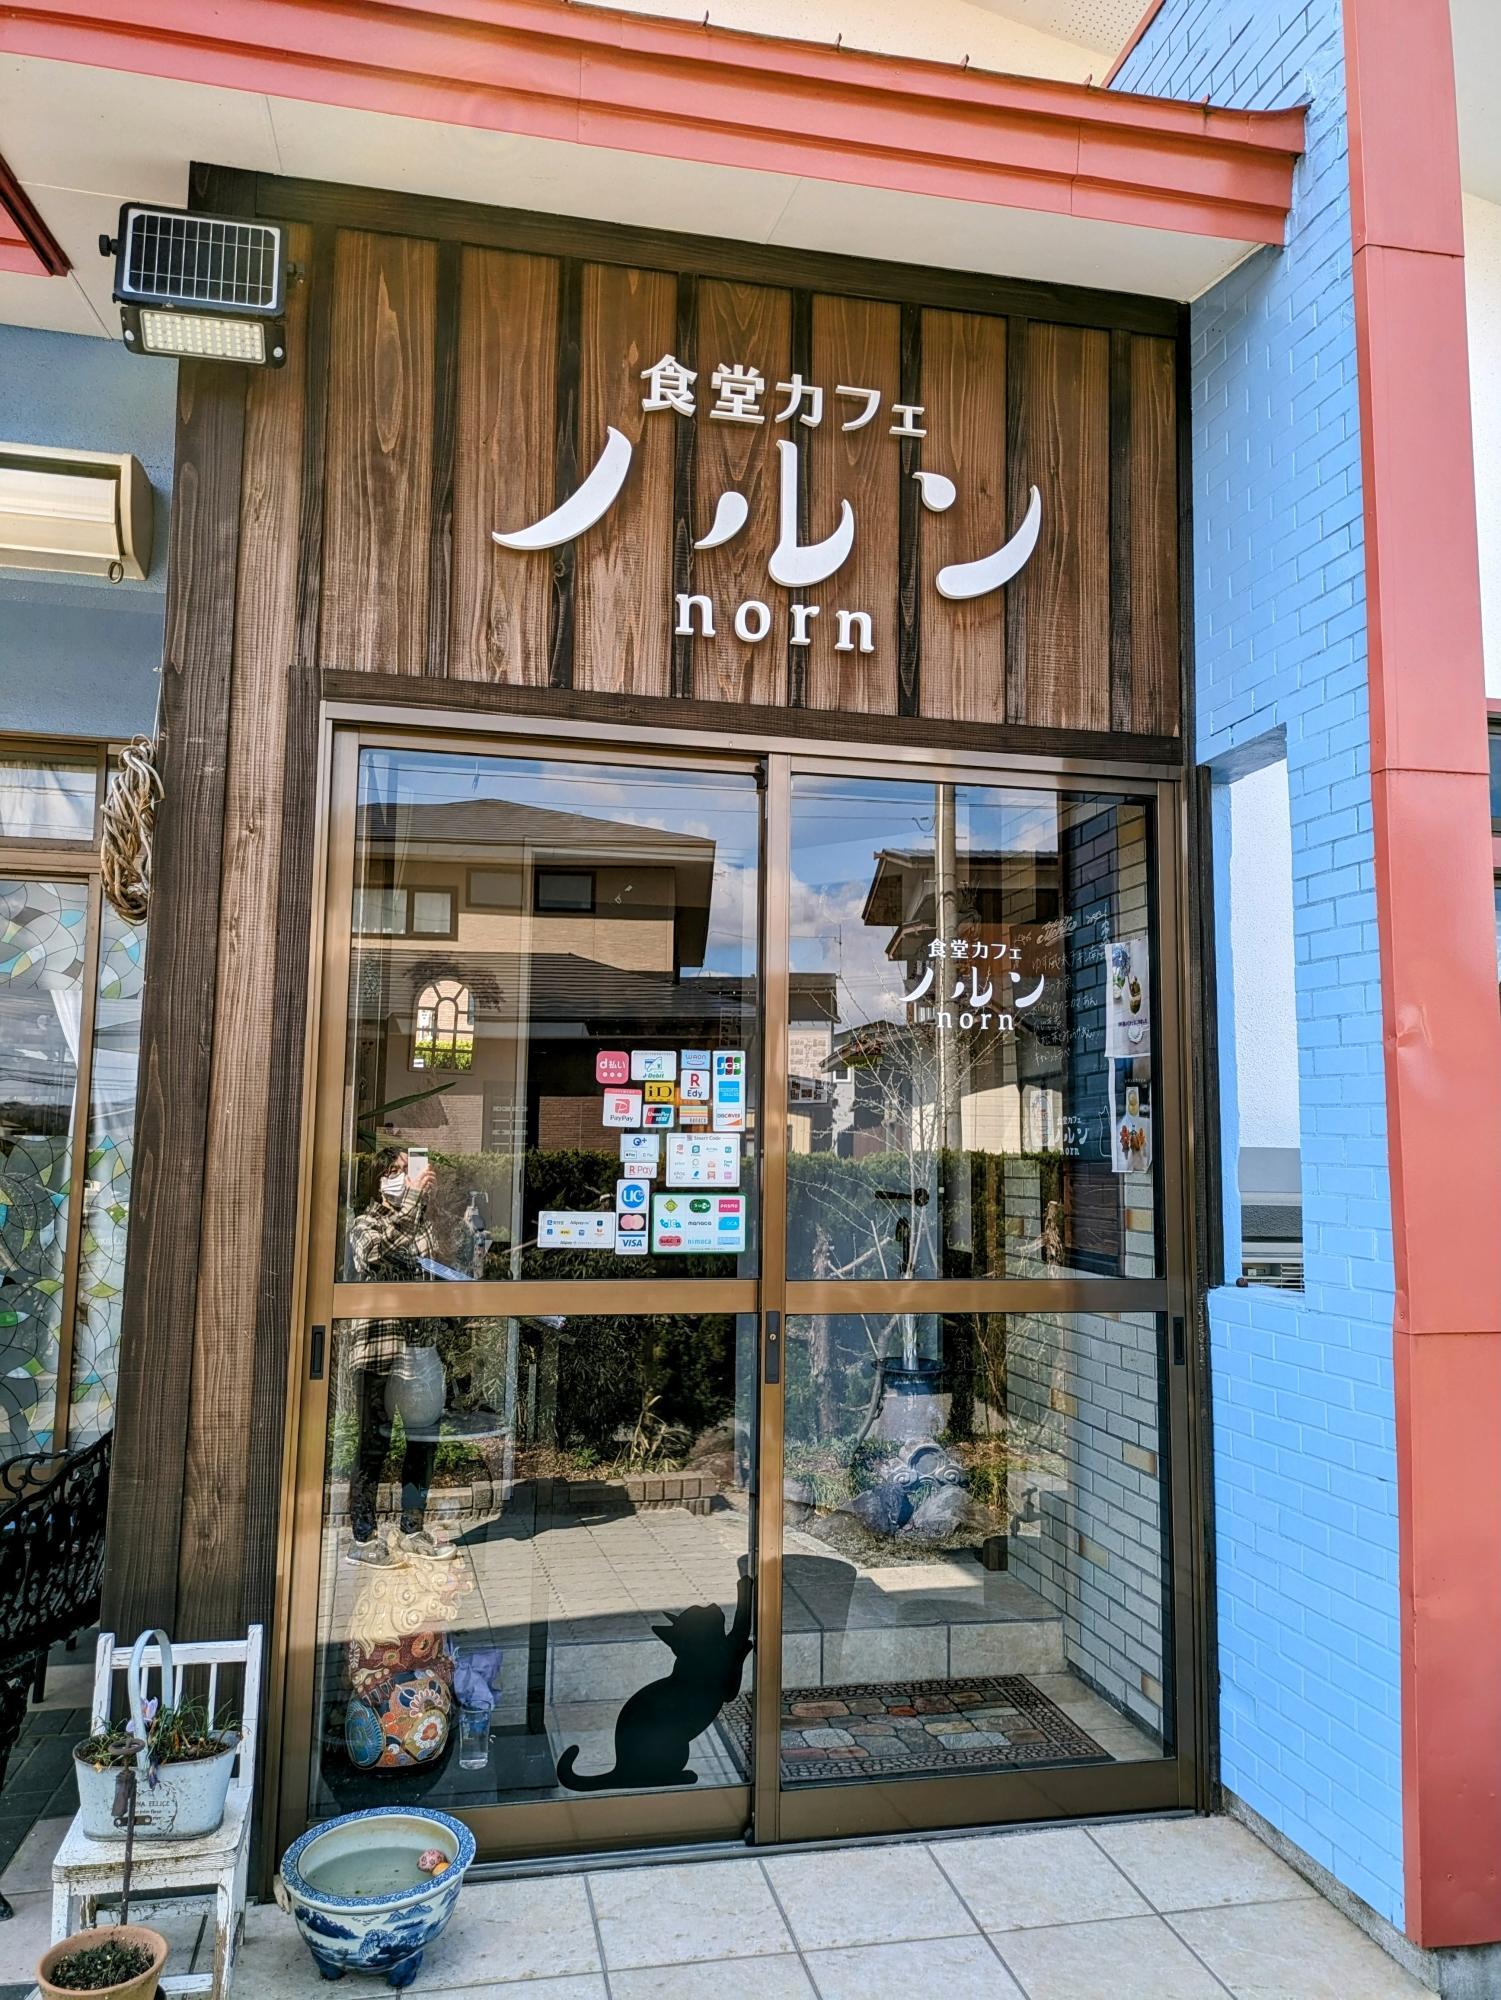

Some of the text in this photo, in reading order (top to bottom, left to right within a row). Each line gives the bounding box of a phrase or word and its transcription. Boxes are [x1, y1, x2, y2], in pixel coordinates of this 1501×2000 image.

[640, 354, 928, 438] 食堂カフェ
[491, 425, 1042, 600] ノルン
[674, 593, 875, 653] norn
[927, 938, 1022, 960] 食堂カフェ
[899, 966, 1045, 1008] ノルン
[936, 1011, 1014, 1030] norn
[648, 1086, 672, 1097] iD
[687, 1089, 703, 1098] Edy
[637, 1166, 653, 1175] Pay
